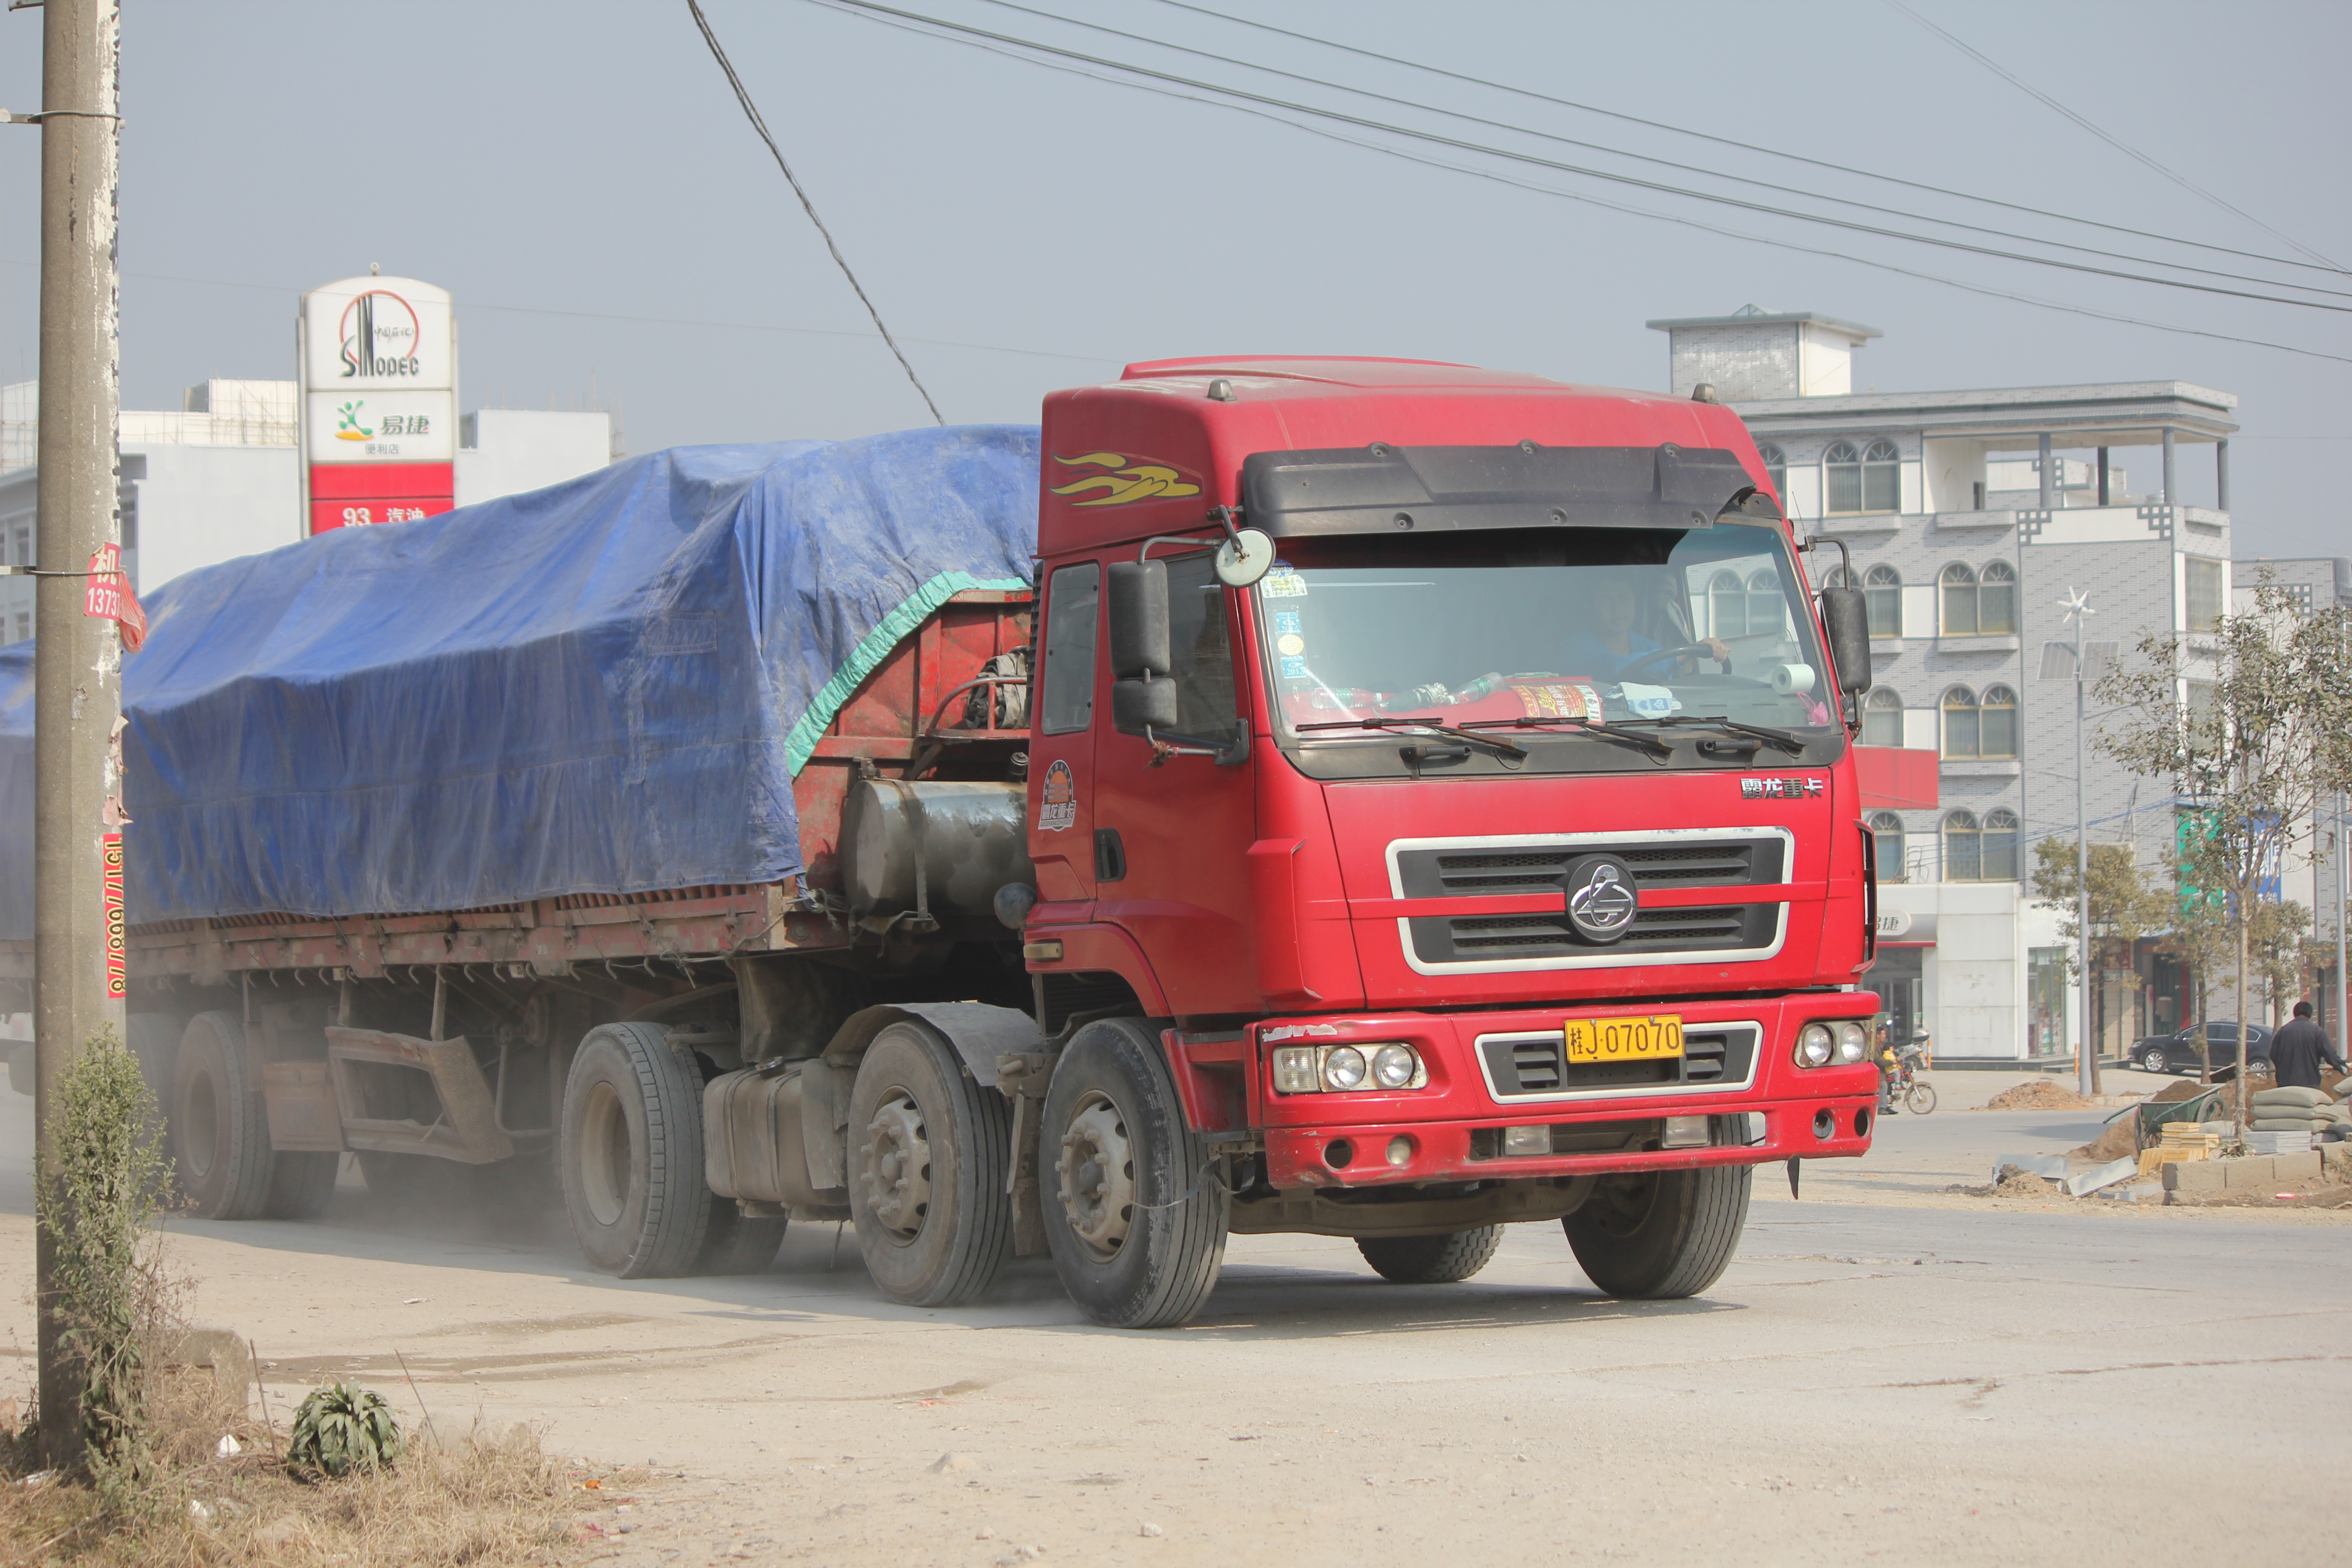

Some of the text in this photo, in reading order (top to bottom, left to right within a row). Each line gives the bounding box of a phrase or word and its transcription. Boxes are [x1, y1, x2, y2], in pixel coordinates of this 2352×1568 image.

[380, 415, 430, 435] 易捷
[365, 443, 399, 454] 便利店
[342, 507, 371, 526] 93
[1740, 777, 1823, 799] 霸龙重卡
[1041, 802, 1074, 820] 霸龙重卡
